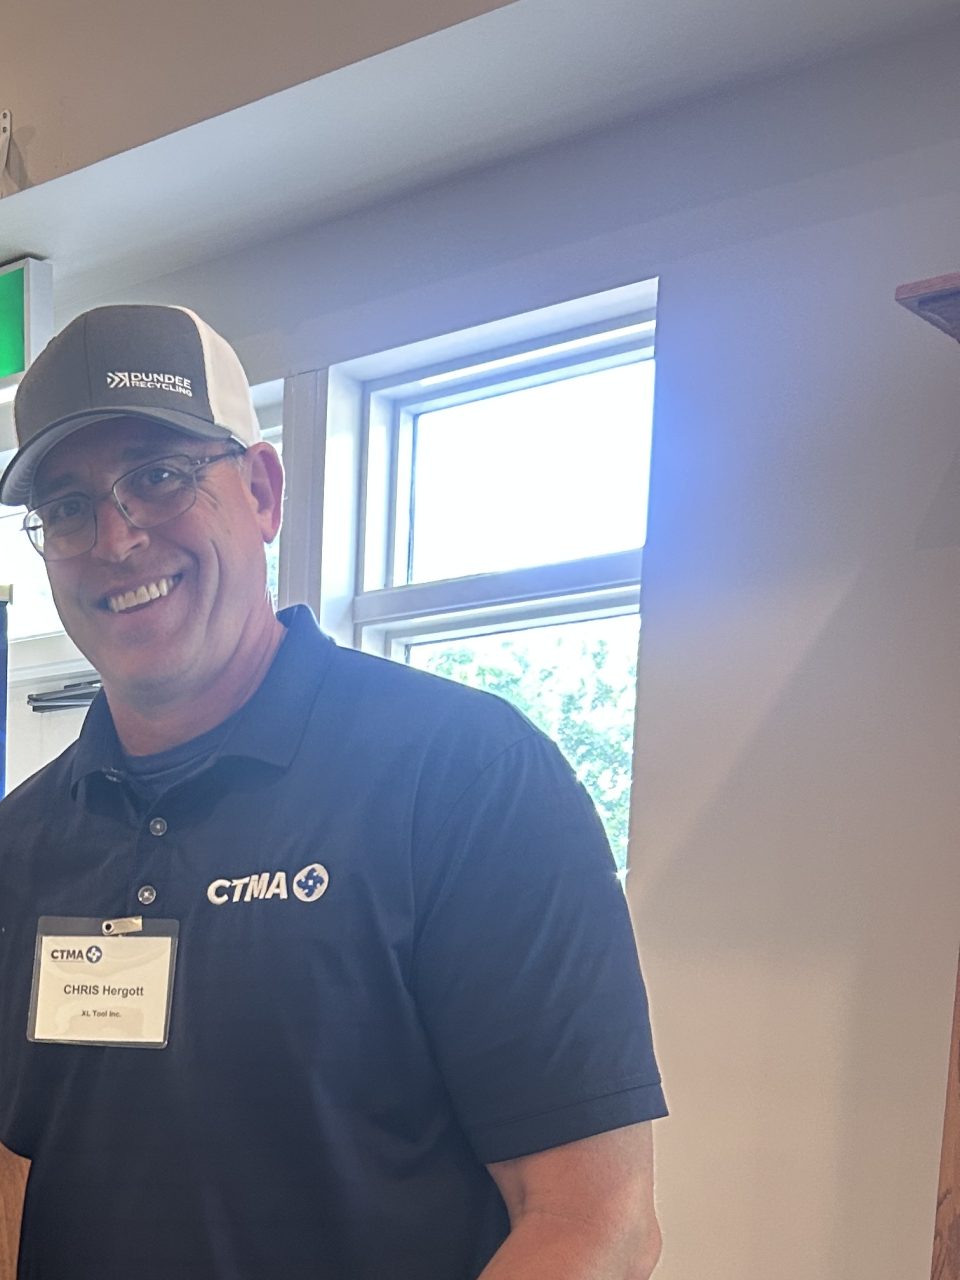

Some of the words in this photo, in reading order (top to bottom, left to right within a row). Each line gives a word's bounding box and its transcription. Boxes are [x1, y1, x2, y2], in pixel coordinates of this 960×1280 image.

[131, 372, 192, 389] DUNDEE
[131, 380, 193, 397] RECYCLING
[207, 871, 288, 905] CTMA
[50, 949, 84, 961] CTMA
[63, 984, 99, 996] CHRIS
[102, 985, 144, 999] Hergott
[81, 1009, 91, 1017] XL
[92, 1009, 108, 1018] Tool
[109, 1010, 122, 1018] Inc.
